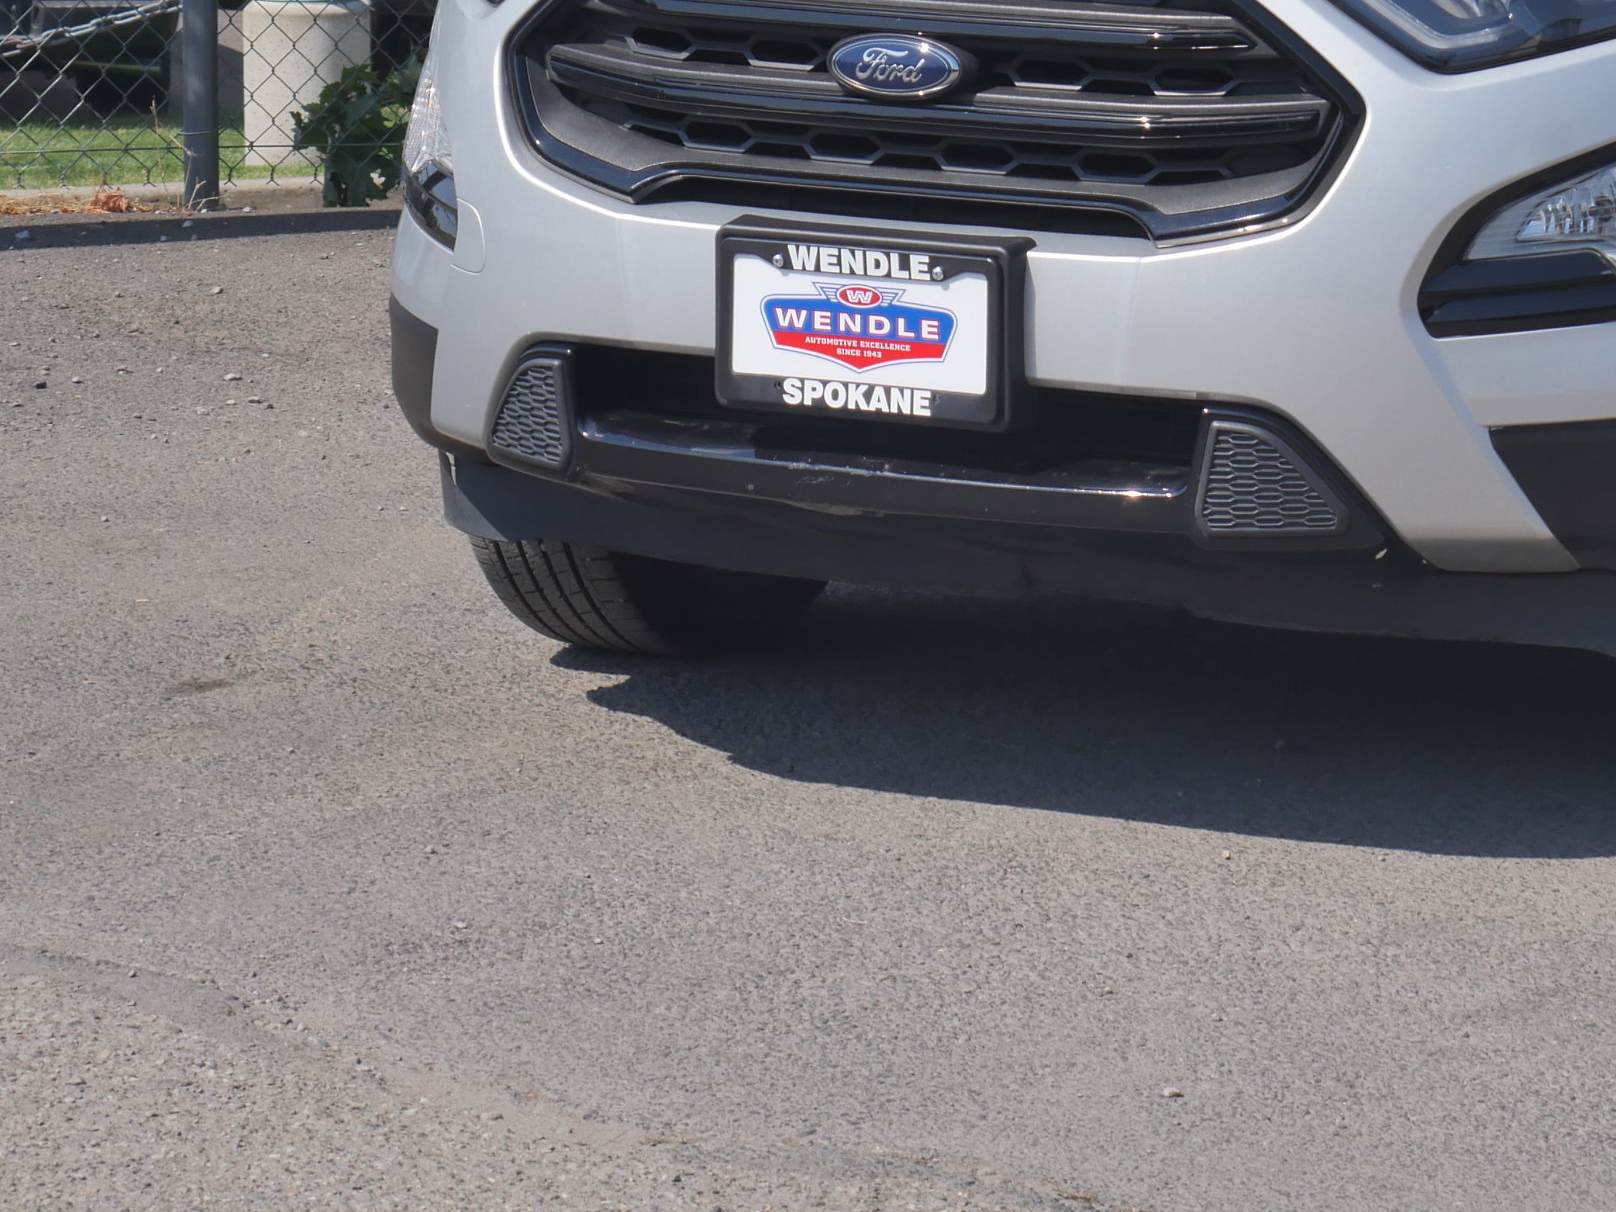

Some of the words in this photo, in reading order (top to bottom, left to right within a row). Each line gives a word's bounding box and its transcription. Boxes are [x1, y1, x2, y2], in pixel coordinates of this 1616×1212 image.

[855, 47, 926, 83] Ford
[787, 244, 931, 281] WENDLE
[774, 307, 940, 340] WENDLE
[805, 336, 858, 348] AUTOMOTIVE
[860, 341, 911, 352] EXCELLENCE
[836, 347, 861, 357] SINCE
[863, 349, 882, 359] 1943
[782, 377, 931, 417] SPOKANE
